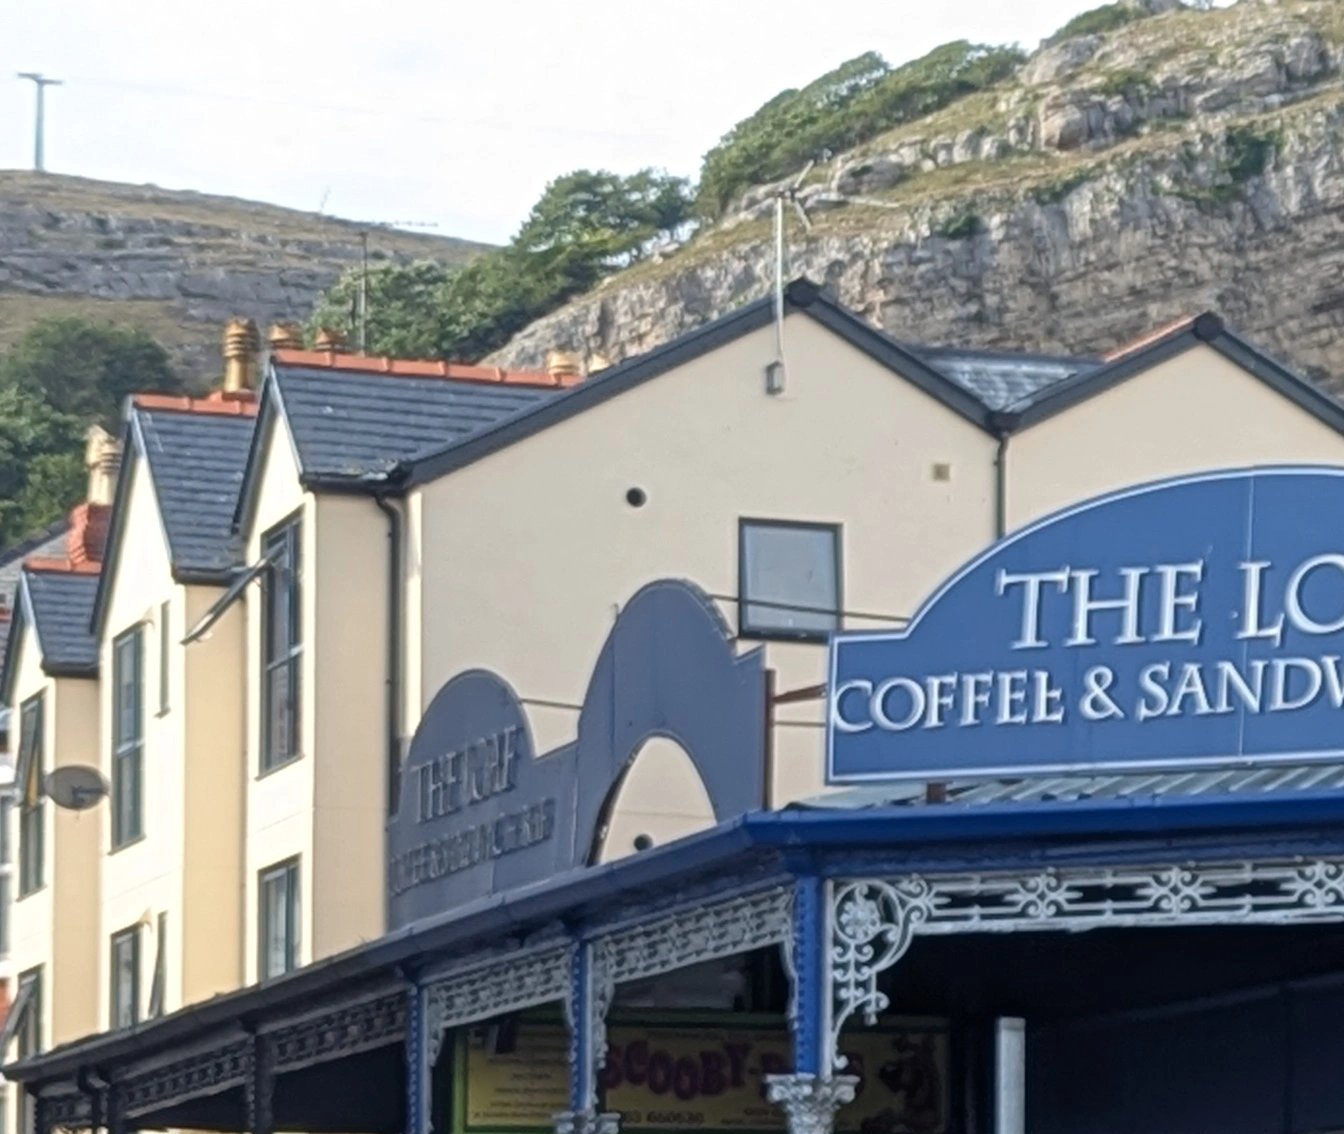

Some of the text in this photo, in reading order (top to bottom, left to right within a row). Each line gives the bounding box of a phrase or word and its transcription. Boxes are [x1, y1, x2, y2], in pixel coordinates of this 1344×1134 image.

[1000, 560, 1206, 652] THE
[833, 670, 1065, 735] COFFEE
[1080, 672, 1125, 720] &
